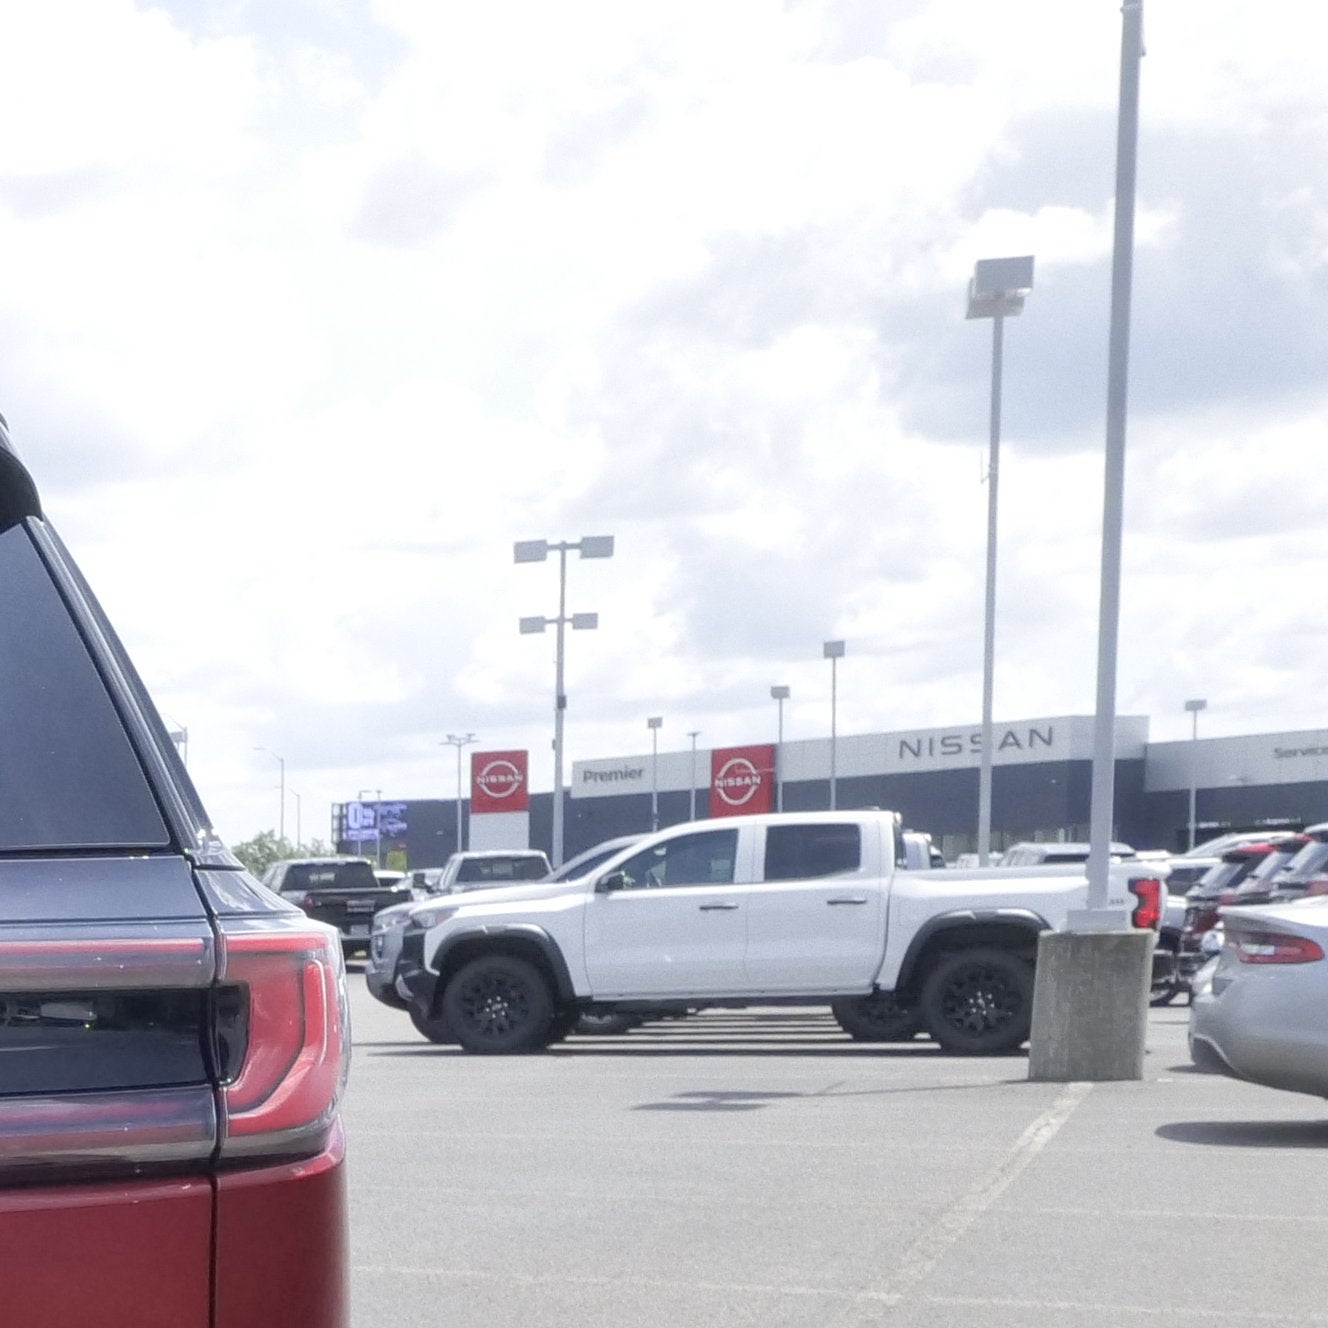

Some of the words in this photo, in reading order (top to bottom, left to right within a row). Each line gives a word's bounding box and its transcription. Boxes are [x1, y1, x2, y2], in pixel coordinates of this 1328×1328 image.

[898, 726, 1053, 759] NISSAN
[476, 773, 523, 784] NISSAN
[582, 766, 645, 782] Premier
[714, 775, 761, 788] NISSAN
